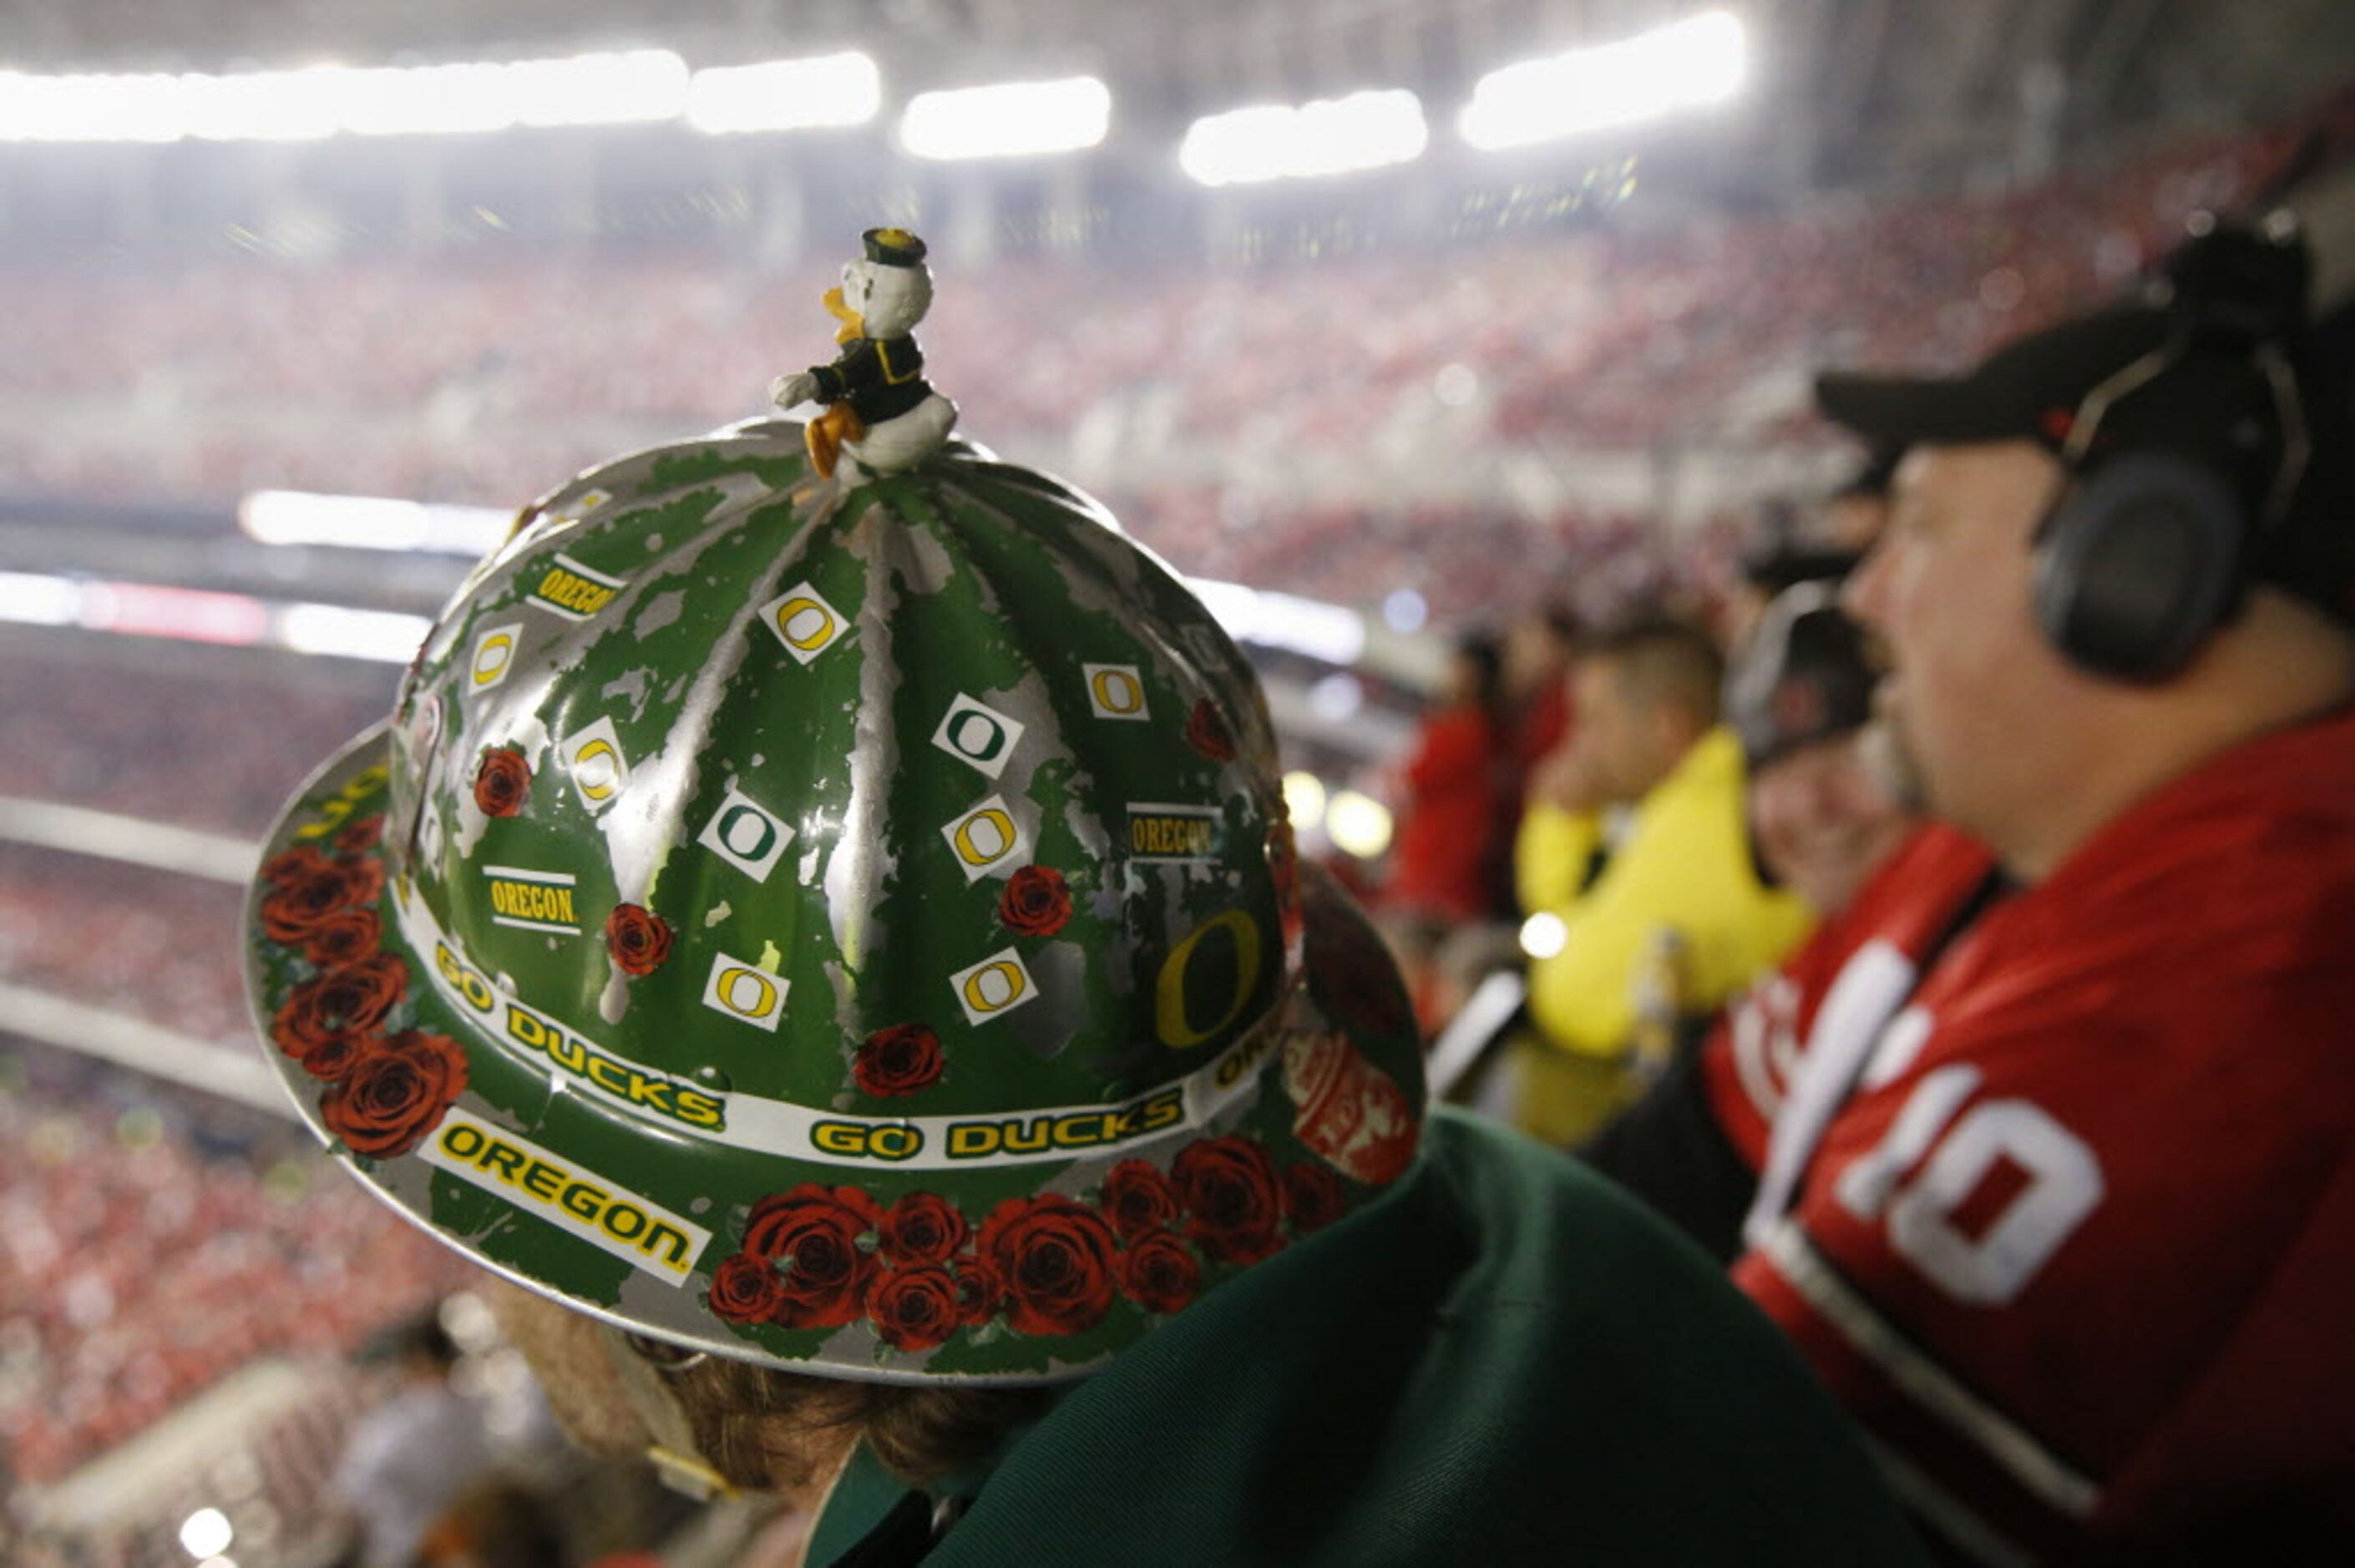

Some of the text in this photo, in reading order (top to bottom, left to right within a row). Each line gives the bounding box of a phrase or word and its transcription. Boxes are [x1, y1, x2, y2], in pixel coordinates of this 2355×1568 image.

[777, 597, 835, 651] O
[473, 633, 513, 685] O
[1091, 670, 1143, 715] O
[946, 709, 1006, 761] O
[717, 804, 777, 862] O
[954, 808, 1017, 867] O
[1132, 817, 1213, 854] OREGON
[490, 879, 576, 923] OREGON
[717, 967, 778, 1019] O
[963, 960, 1026, 1013] O
[1156, 908, 1261, 1049] O
[435, 940, 727, 1134] GO DUCKS
[809, 1085, 1186, 1162] GO DUCKS
[438, 1123, 691, 1273] OREGON
